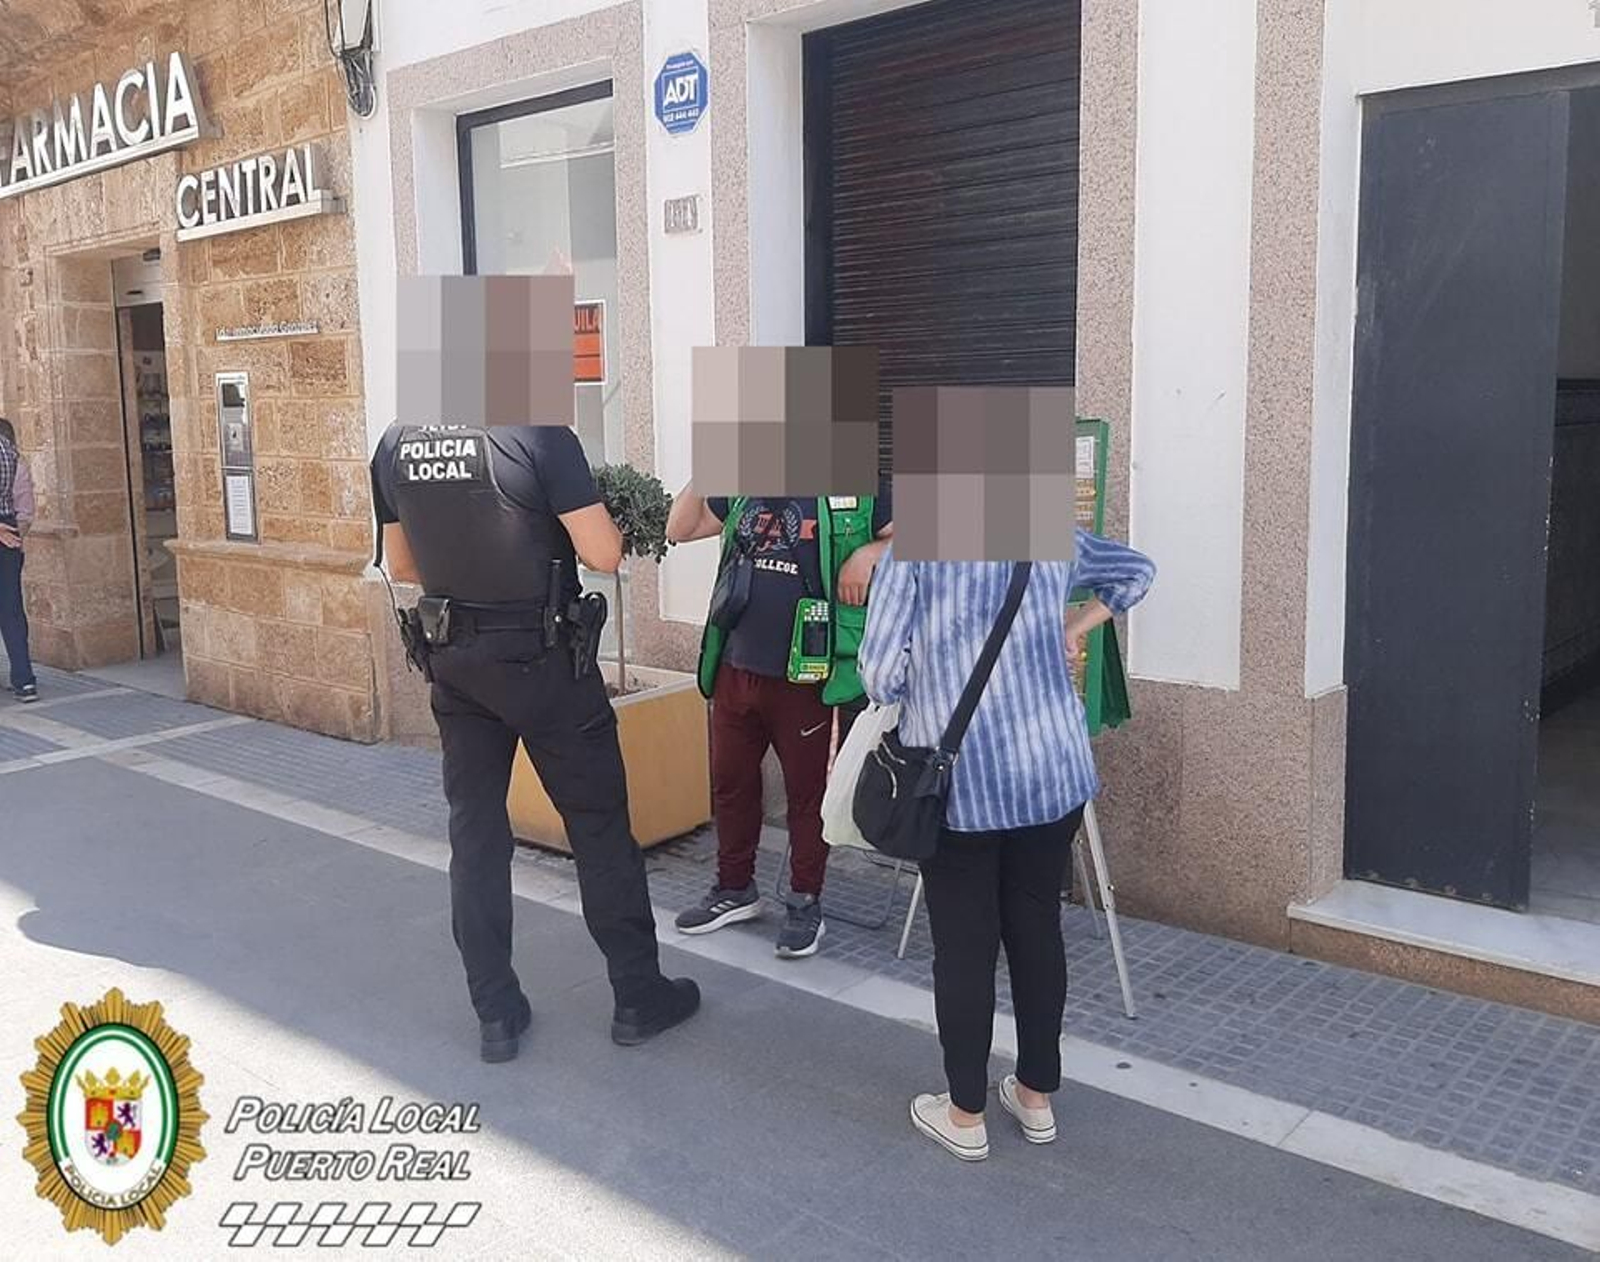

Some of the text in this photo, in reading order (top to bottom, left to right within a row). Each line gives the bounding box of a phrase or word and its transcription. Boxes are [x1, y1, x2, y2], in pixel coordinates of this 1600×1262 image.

[663, 74, 699, 107] ADT
[0, 51, 198, 186] ARMACIA
[176, 143, 322, 228] CENTRAL
[574, 305, 602, 332] UILA
[400, 439, 477, 460] POLICIA
[408, 461, 472, 481] LOCAL
[755, 558, 799, 575] OLLEGE
